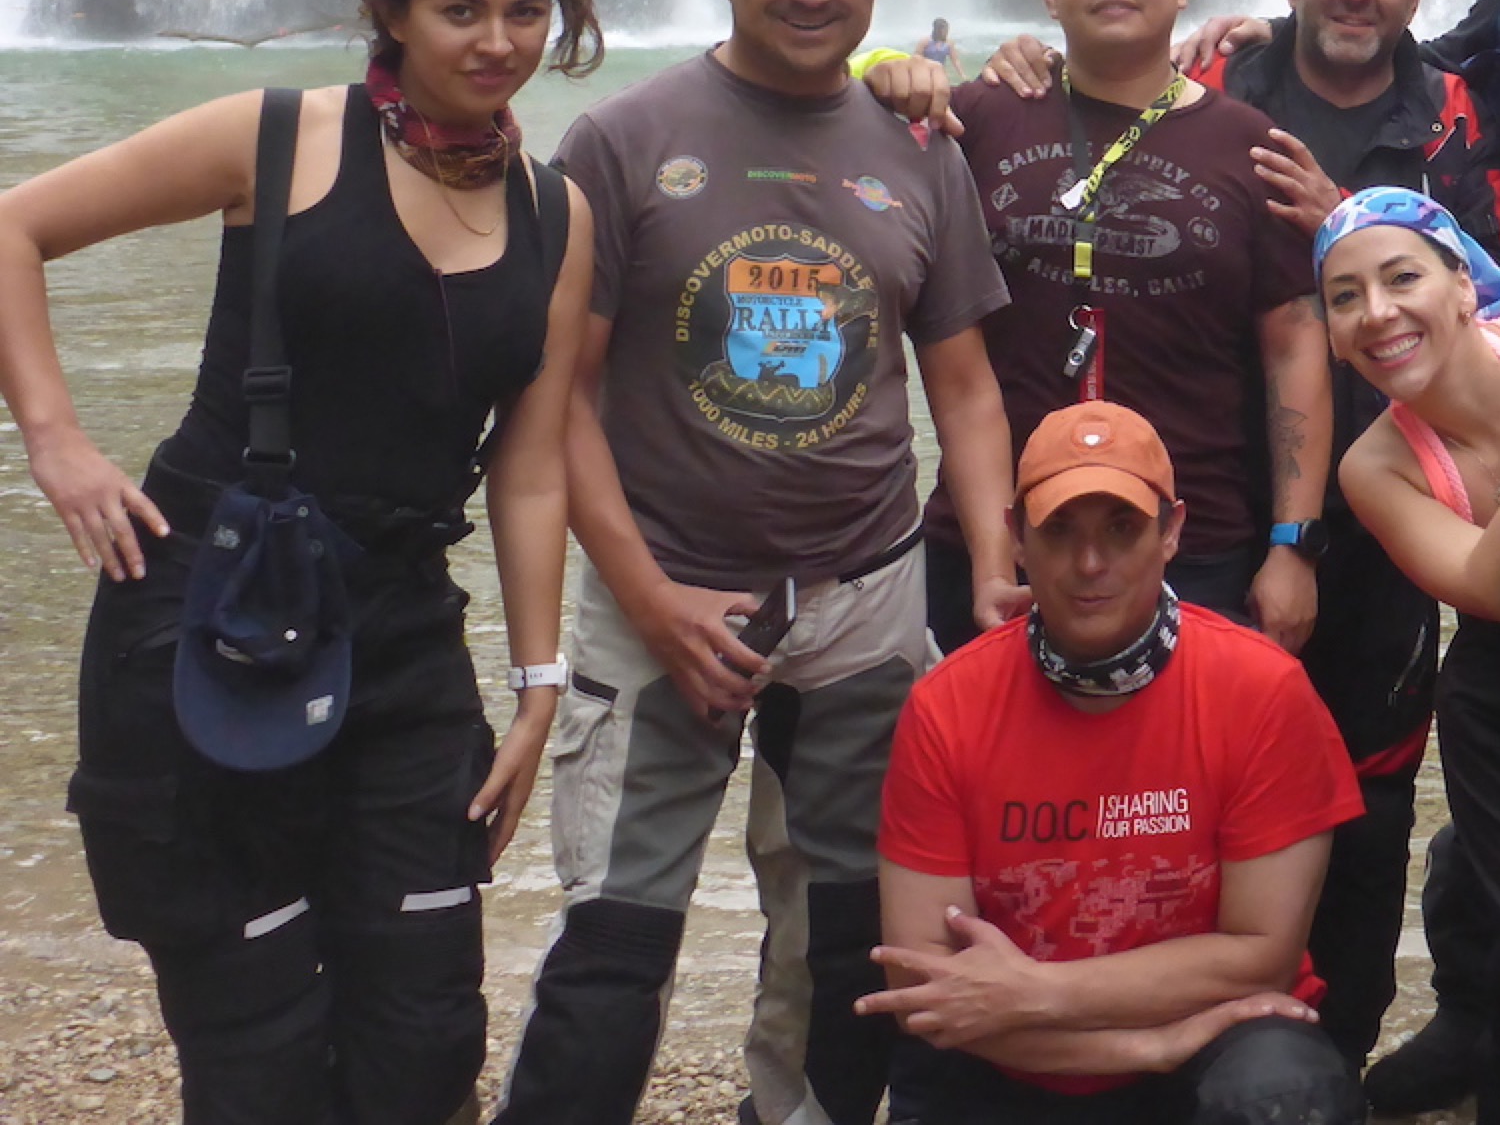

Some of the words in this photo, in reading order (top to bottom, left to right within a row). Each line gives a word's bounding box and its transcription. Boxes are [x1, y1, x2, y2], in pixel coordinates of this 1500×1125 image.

[718, 417, 779, 450] MILES
[795, 428, 820, 449] 24
[821, 382, 868, 440] HOURS
[1105, 788, 1189, 819] SHARING
[1101, 819, 1131, 839] OUR
[1132, 813, 1192, 836] PASSION
